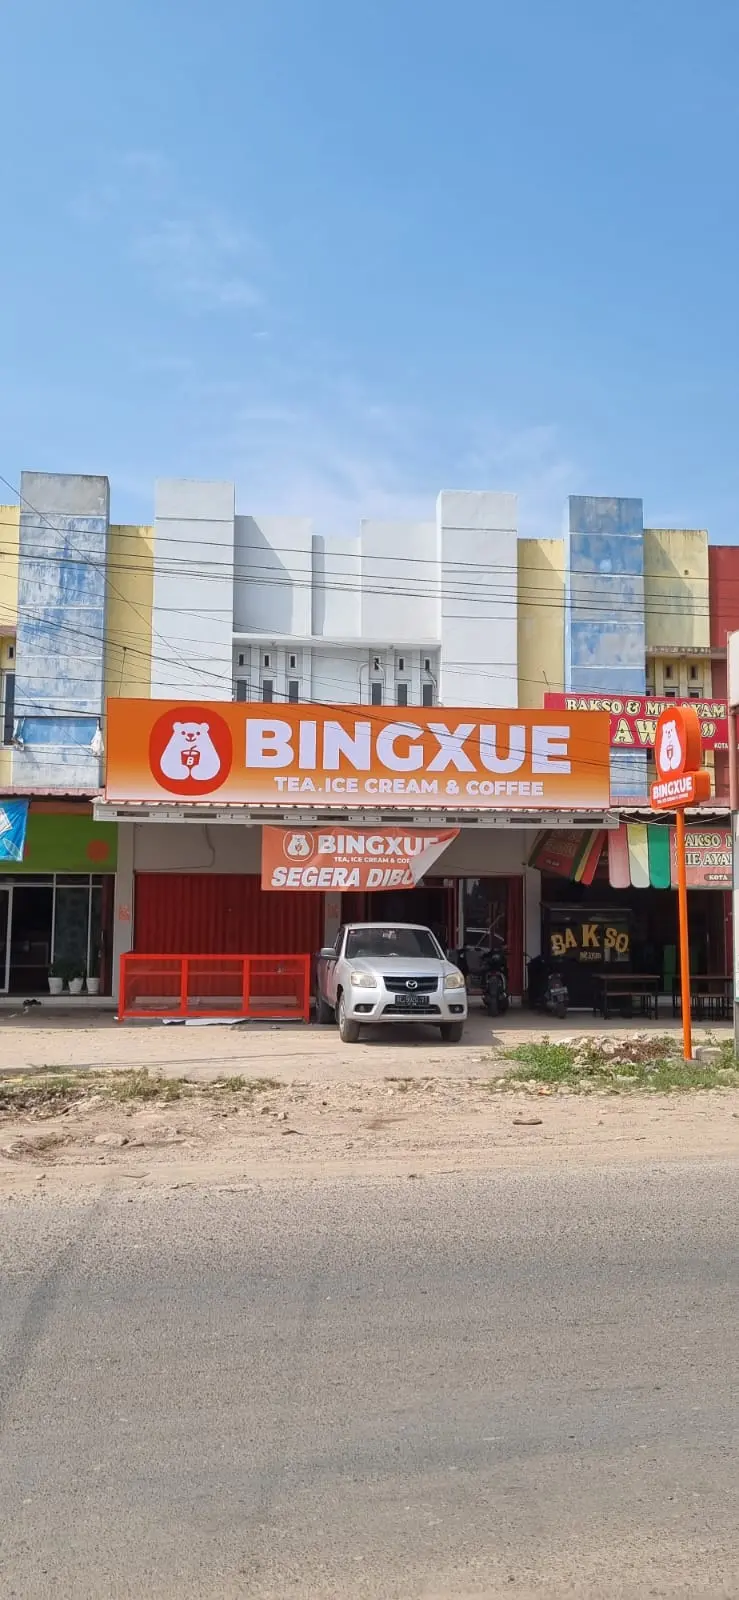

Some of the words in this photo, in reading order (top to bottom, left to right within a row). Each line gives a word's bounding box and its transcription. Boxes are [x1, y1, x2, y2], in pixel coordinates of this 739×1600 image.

[565, 699, 622, 715] BAKSO
[627, 700, 640, 714] &
[246, 719, 571, 774] BINGXUE
[364, 779, 438, 795] CREAM
[445, 780, 458, 795] &
[466, 781, 544, 796] COFFEE
[651, 777, 693, 801] BINGXUE
[675, 833, 721, 848] AKSO
[271, 867, 360, 887] SEGERA
[366, 868, 415, 888] DIBU
[551, 923, 629, 956] BAKSO
